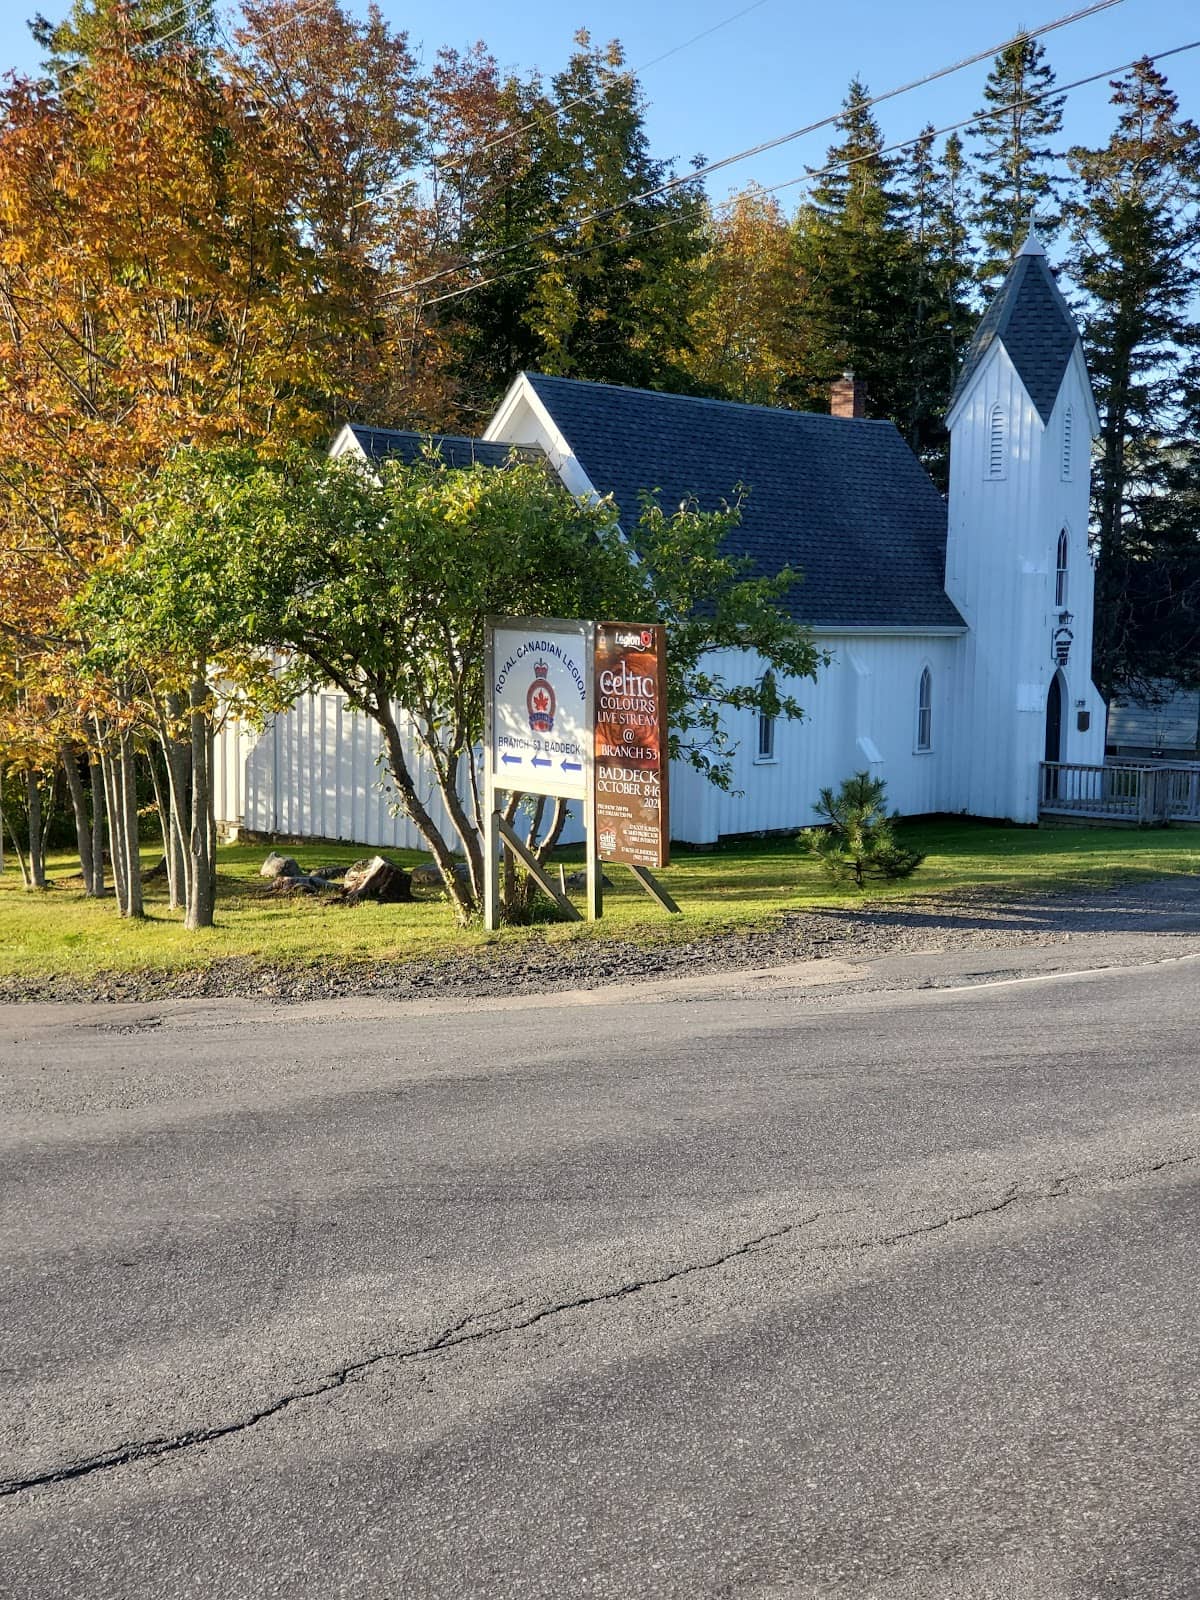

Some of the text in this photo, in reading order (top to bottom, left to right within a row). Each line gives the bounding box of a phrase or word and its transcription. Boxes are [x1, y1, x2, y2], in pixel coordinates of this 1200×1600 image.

[615, 632, 641, 647] Legion
[495, 640, 586, 701] ROYAL CANADIAN LEGION
[600, 660, 655, 698] Celtic
[600, 696, 656, 713] COLOURS
[597, 711, 617, 724] LIVE
[622, 728, 635, 744] @
[498, 736, 529, 750] BRANCH
[544, 741, 581, 755] BADDECK
[601, 744, 658, 761] BRANCH 53
[599, 766, 660, 785] BADDECK
[597, 780, 642, 796] OCTOBER
